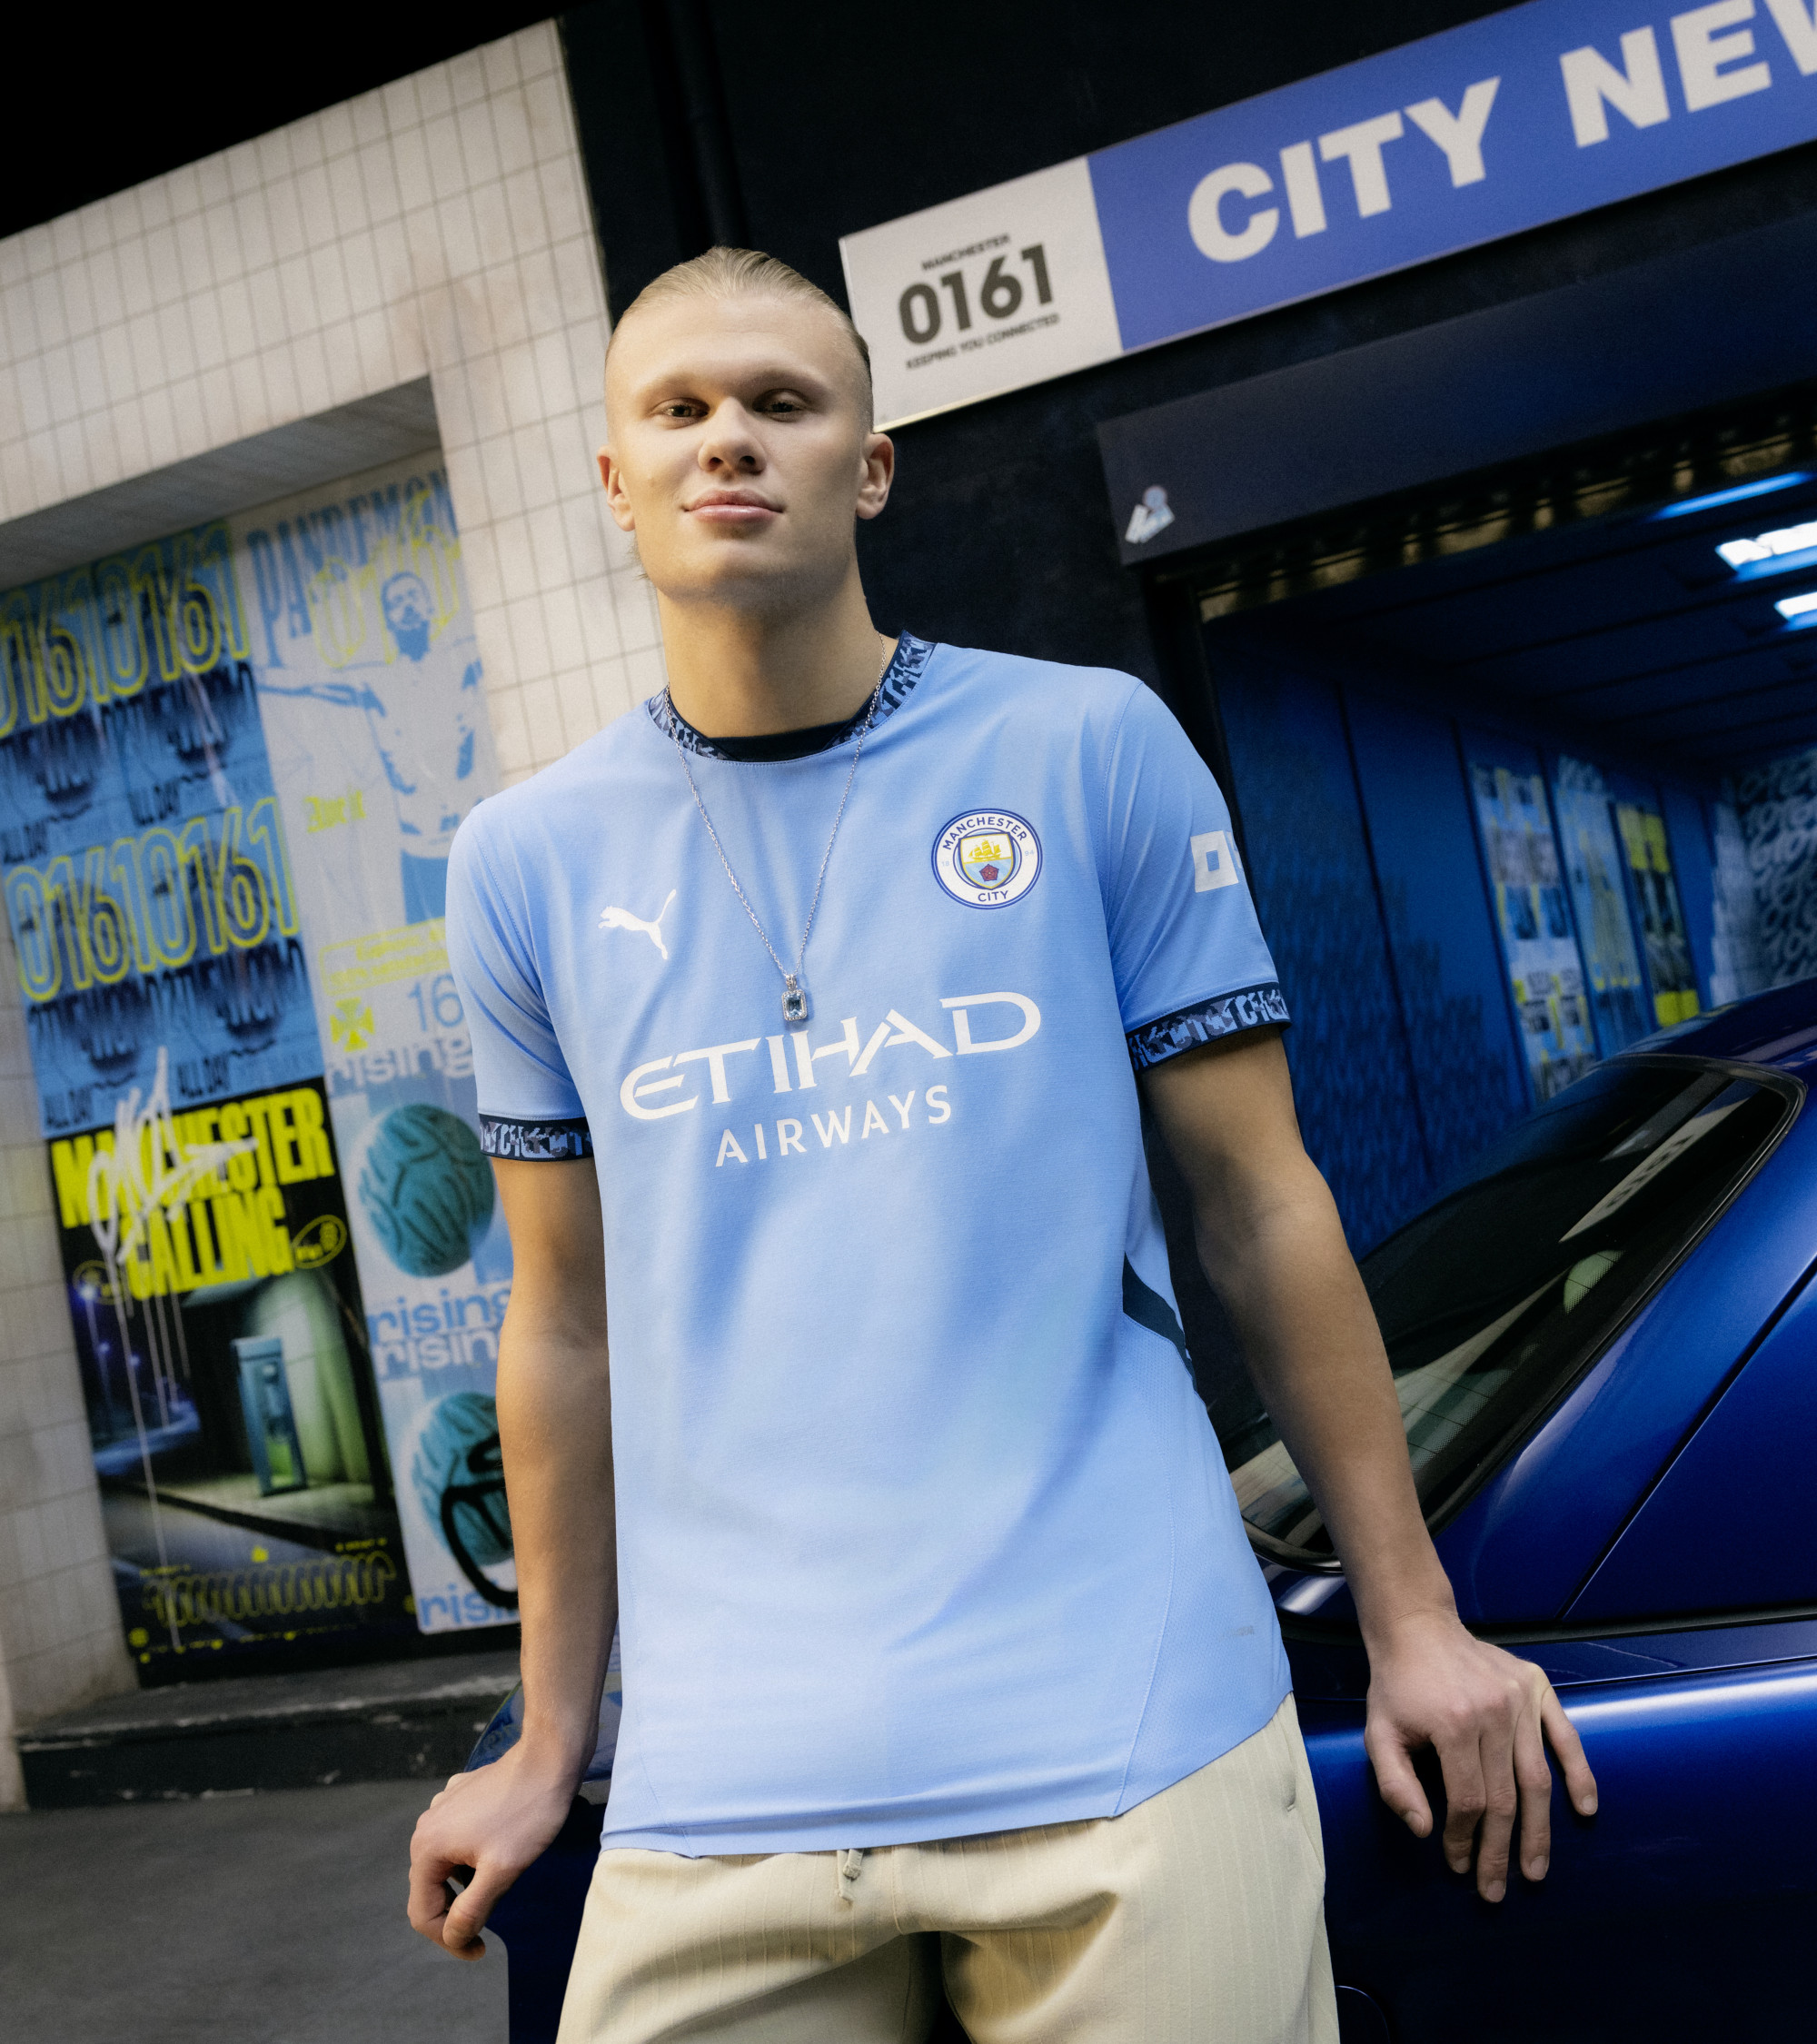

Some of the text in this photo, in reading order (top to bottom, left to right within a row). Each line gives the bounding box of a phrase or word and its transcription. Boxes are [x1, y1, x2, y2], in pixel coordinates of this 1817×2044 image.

[1187, 74, 1502, 263] CITY
[921, 233, 1010, 272] MANCHESTER
[899, 243, 1053, 346] 0161
[959, 334, 985, 353] YOU
[986, 313, 1061, 344] CONNECTED
[942, 816, 1028, 850] MANCHESTER
[978, 889, 1009, 902] CITY
[328, 1034, 476, 1096] rising
[619, 991, 1042, 1121] ETIHAD
[715, 1085, 953, 1168] AIRWAYS
[119, 1186, 295, 1300] CALLING
[372, 1328, 498, 1377] risin
